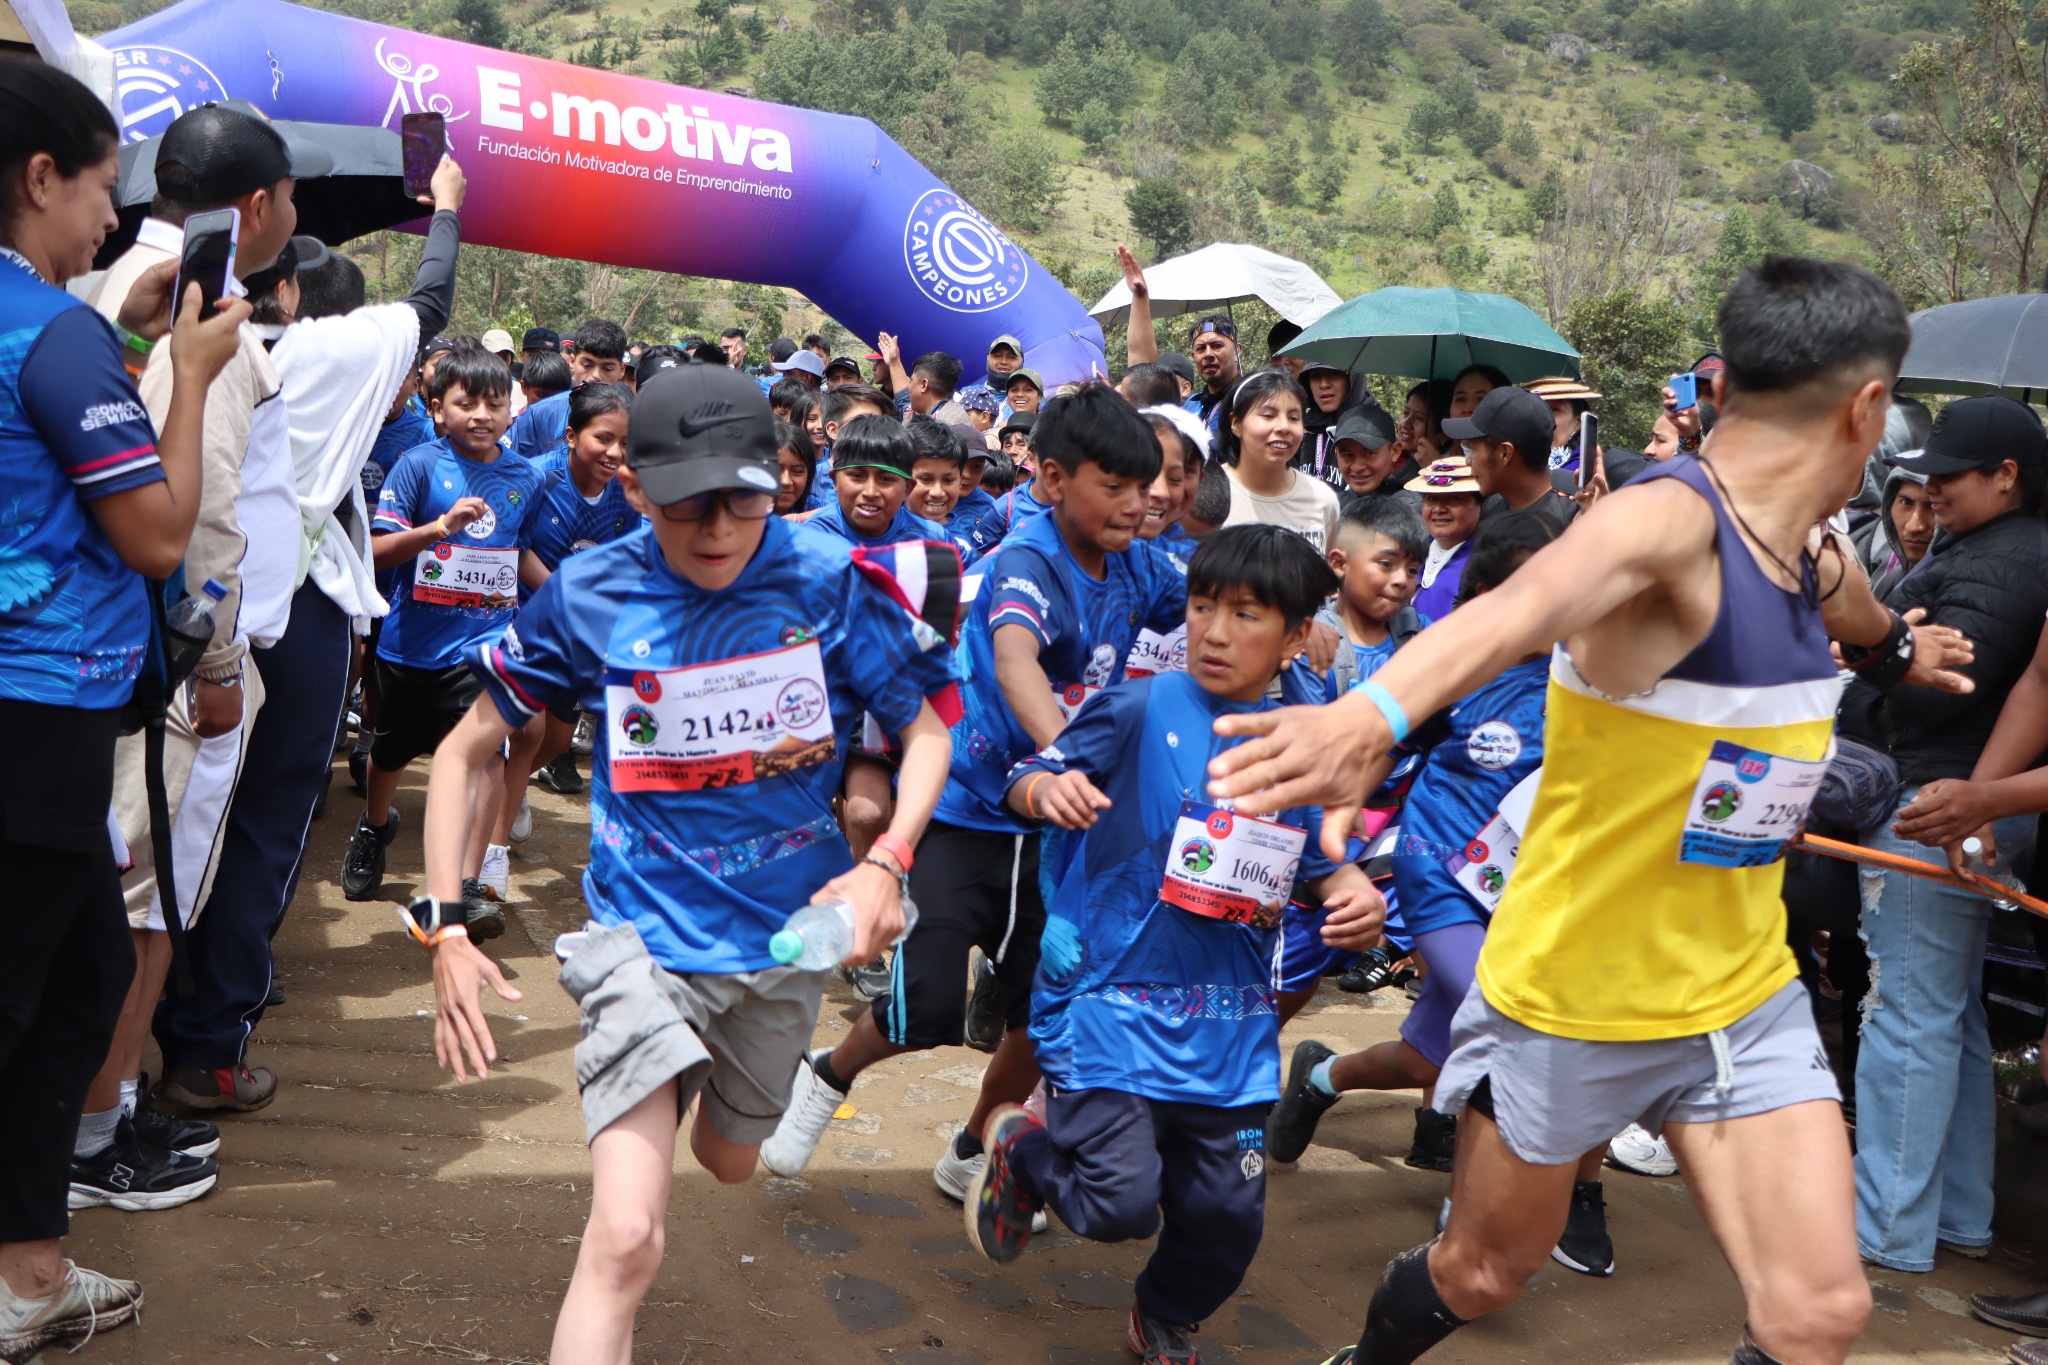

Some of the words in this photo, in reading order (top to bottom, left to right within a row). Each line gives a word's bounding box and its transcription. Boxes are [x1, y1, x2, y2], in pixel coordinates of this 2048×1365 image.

[478, 135, 561, 166] Fundación
[564, 150, 650, 180] Motivadora
[653, 166, 673, 183] de
[676, 169, 792, 200] Emprendimiento
[911, 221, 1008, 305] CAMPEONES
[455, 569, 486, 585] 3431
[639, 679, 655, 693] 3K
[703, 676, 726, 686] JUAN
[1068, 690, 1081, 699] 3K
[681, 708, 752, 742] 2142
[1212, 818, 1228, 831] 3K
[1230, 858, 1272, 885] 1606
[1236, 1128, 1263, 1141] IRON
[1239, 1138, 1263, 1150] MAN
